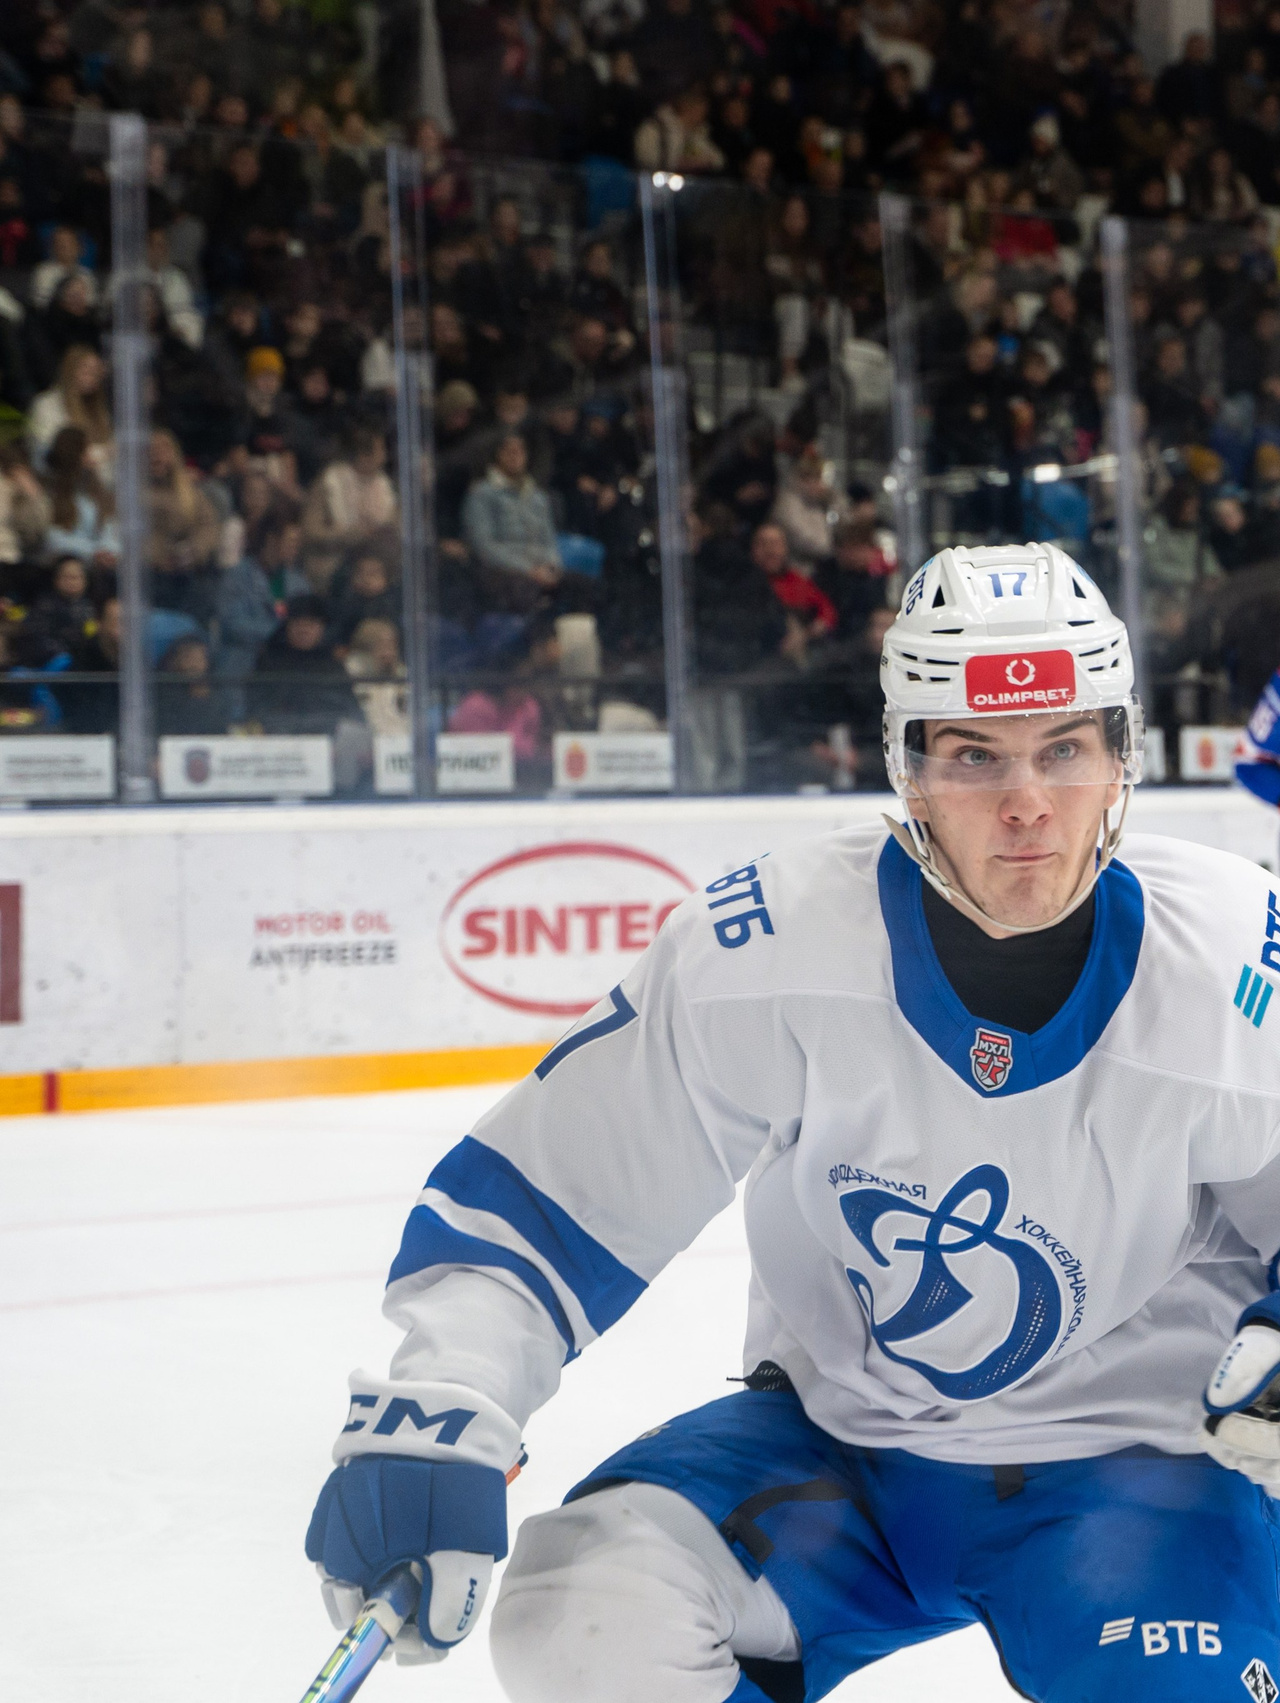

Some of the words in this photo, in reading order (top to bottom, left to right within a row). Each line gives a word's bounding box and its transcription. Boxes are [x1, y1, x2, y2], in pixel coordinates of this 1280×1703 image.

[988, 571, 1028, 598] 17
[973, 687, 1071, 706] OLIMPBET
[705, 863, 776, 950] ВТБ
[254, 912, 344, 937] MOTOR
[353, 909, 391, 934] OIL
[456, 1577, 478, 1632] CCM
[1141, 1620, 1222, 1656] ВТБ
